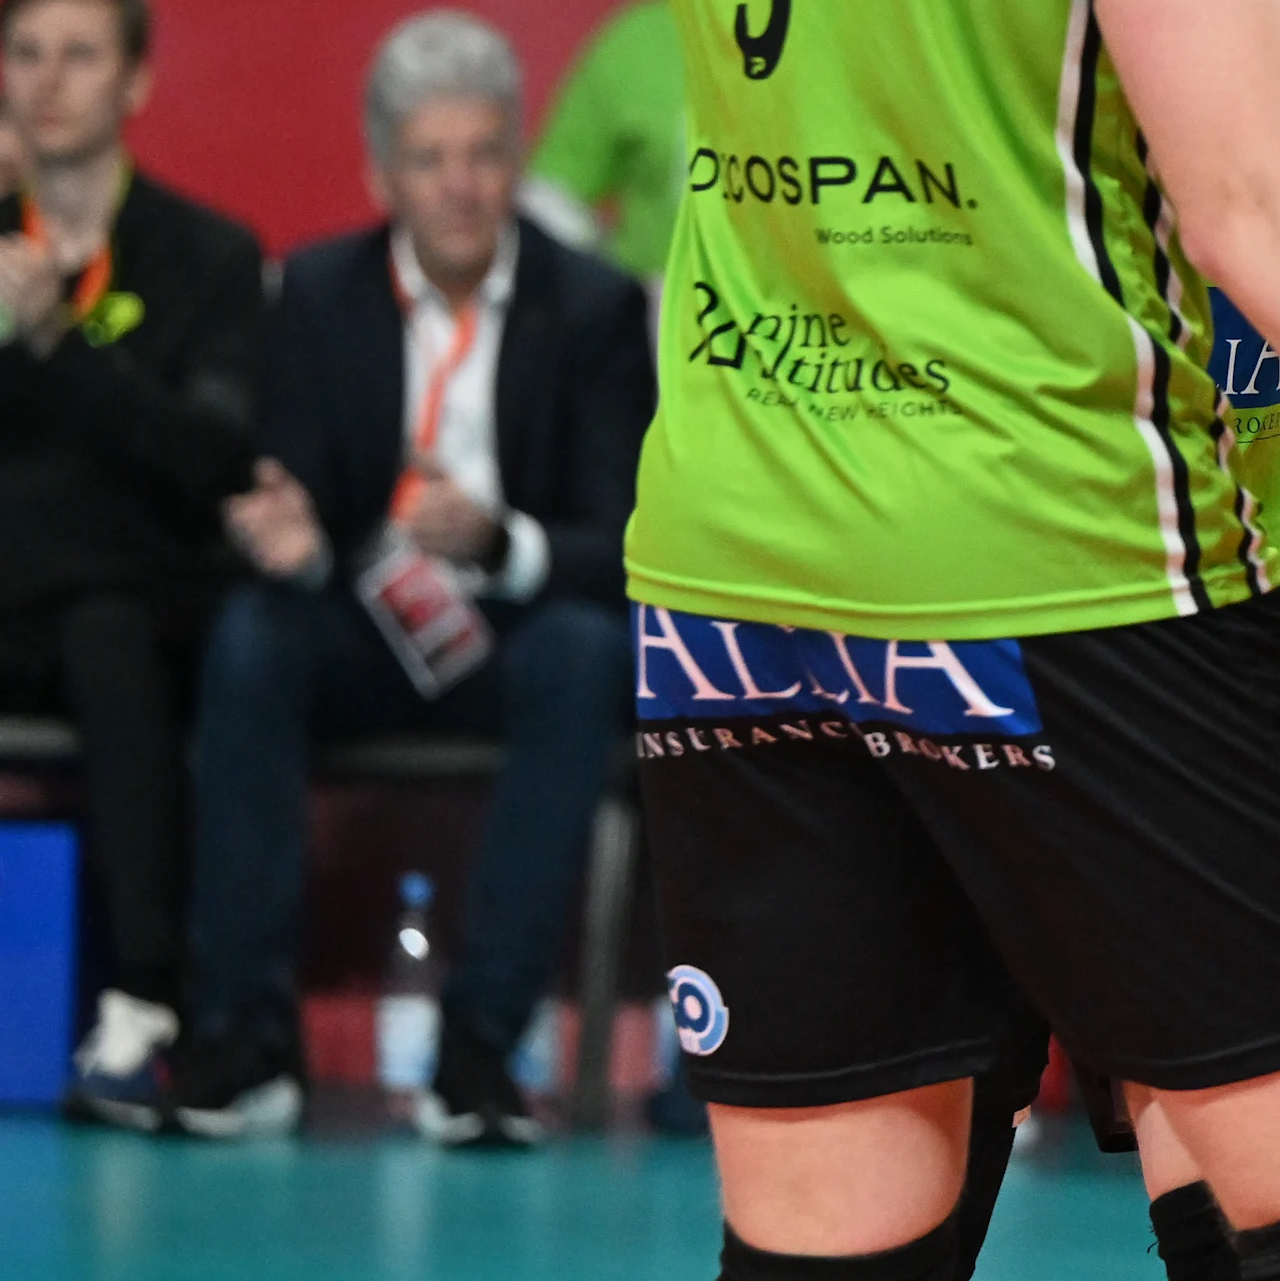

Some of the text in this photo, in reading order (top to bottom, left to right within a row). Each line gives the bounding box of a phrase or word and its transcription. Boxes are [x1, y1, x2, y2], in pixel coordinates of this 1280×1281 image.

[816, 225, 974, 246] Wood Solutions
[637, 719, 1055, 771] INSURANC BROKERS
